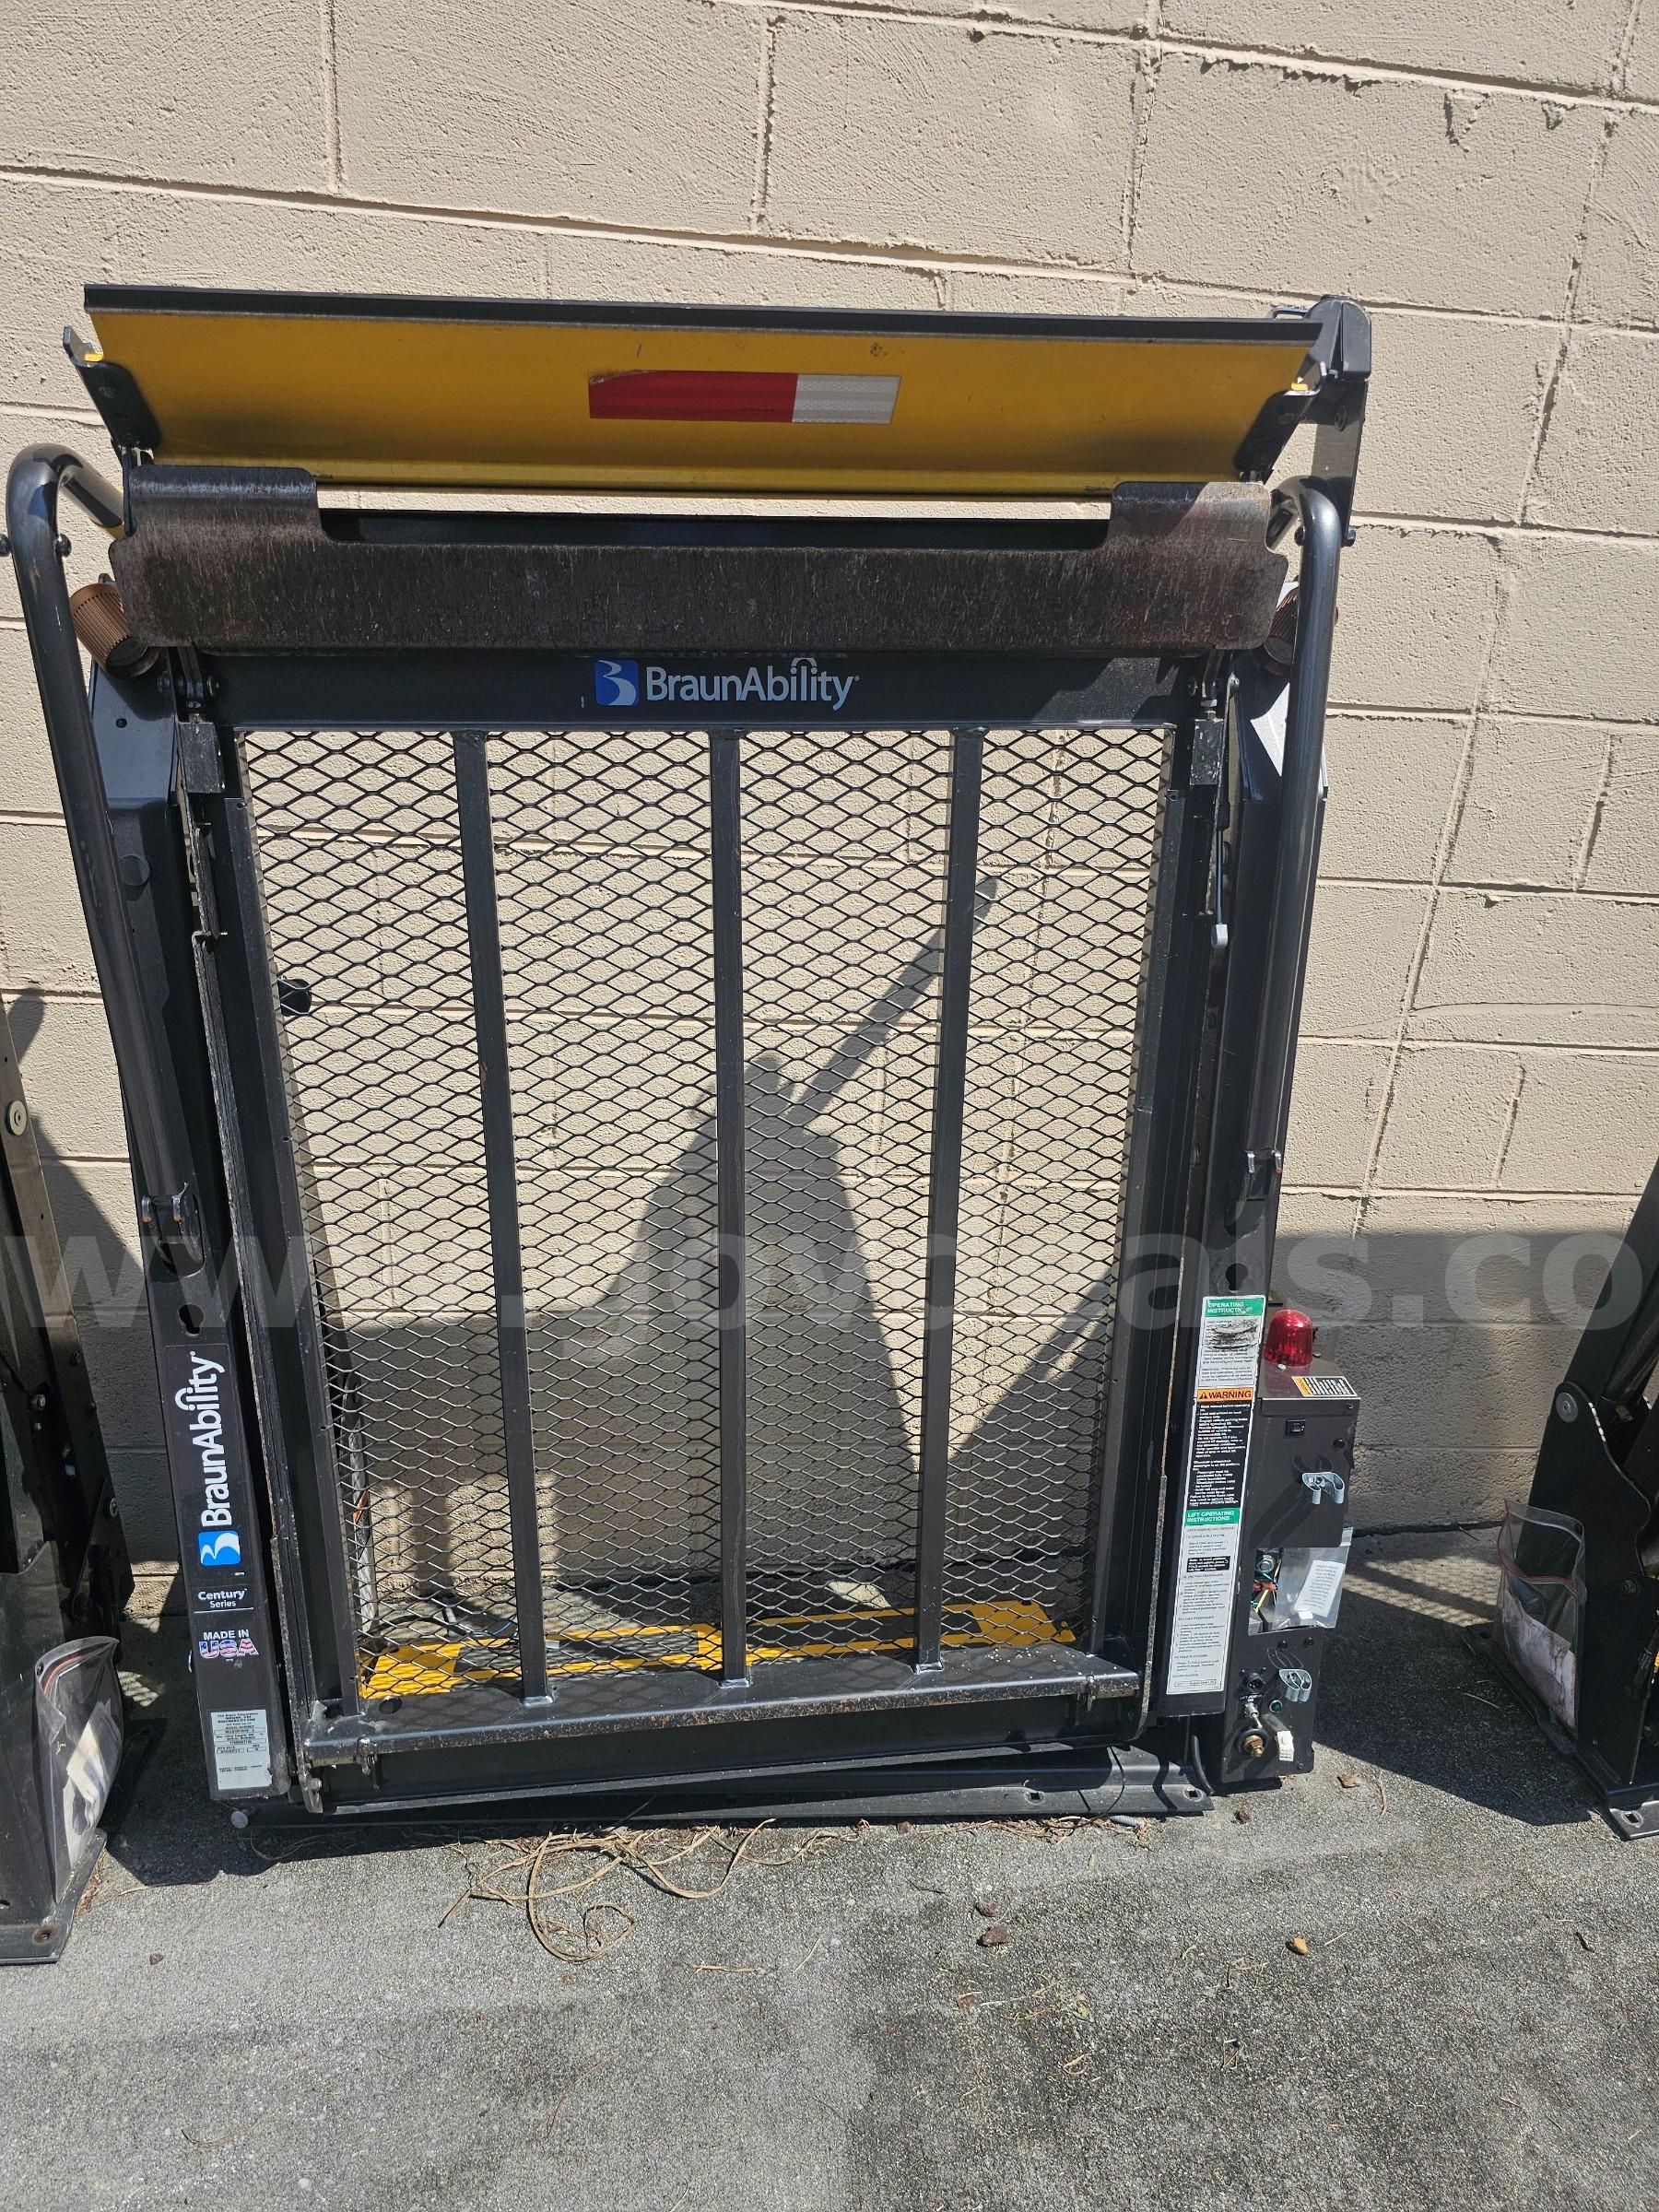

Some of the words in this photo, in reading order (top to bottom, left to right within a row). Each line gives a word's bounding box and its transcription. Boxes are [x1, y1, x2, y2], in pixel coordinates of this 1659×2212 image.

[1208, 1390, 1252, 1399] WARNING
[209, 1600, 236, 1608] Series
[203, 1630, 236, 1641] MADE
[238, 1629, 250, 1637] IN
[198, 1638, 259, 1658] USA
